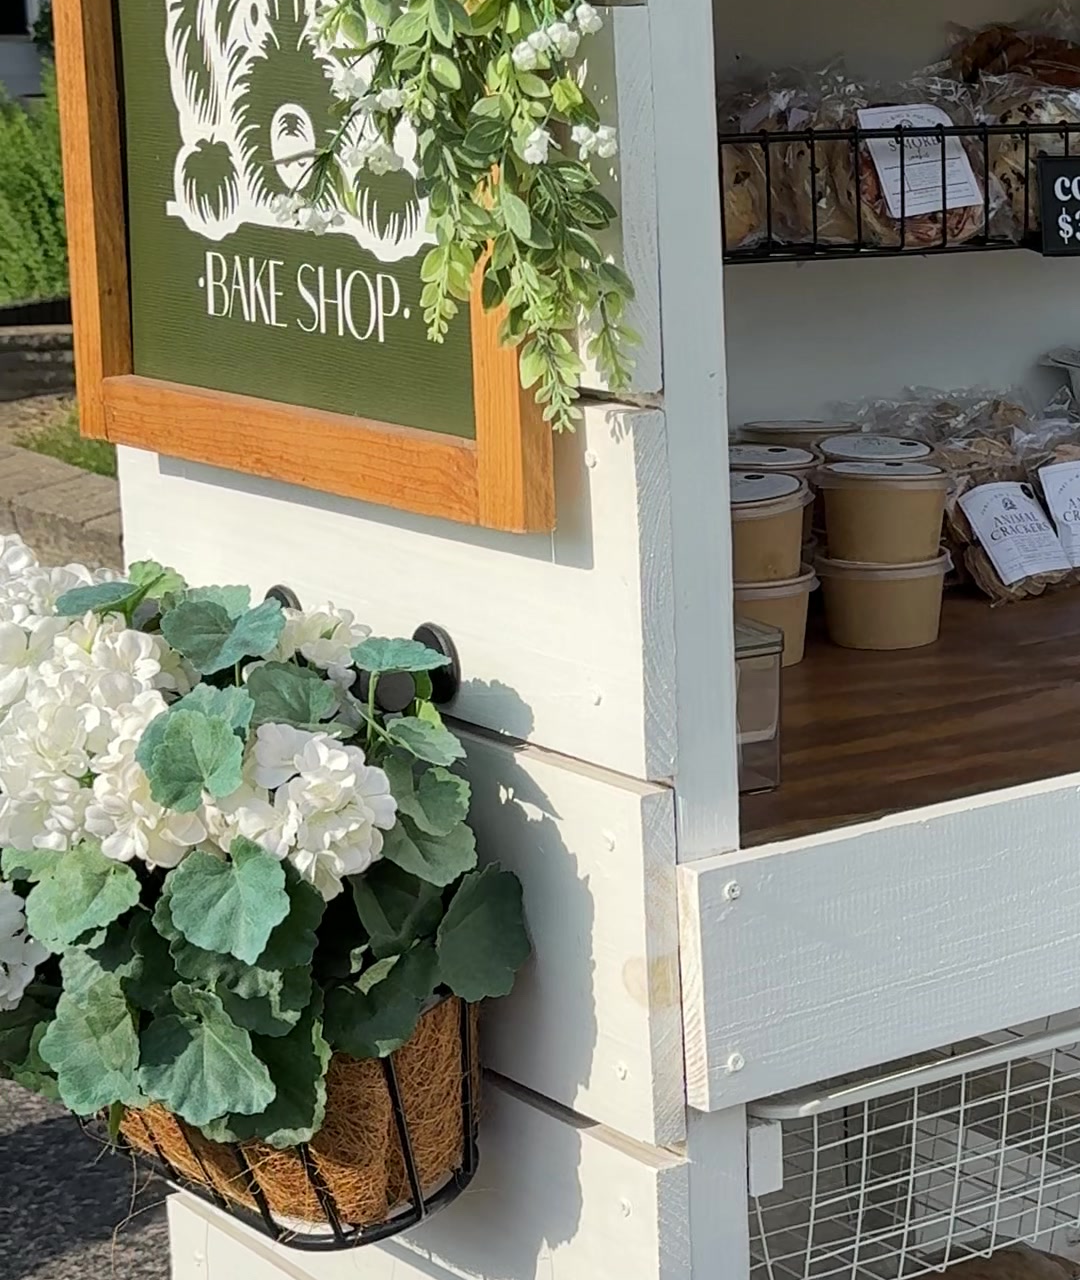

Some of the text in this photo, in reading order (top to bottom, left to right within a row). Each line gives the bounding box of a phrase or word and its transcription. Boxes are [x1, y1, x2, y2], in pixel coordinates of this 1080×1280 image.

[205, 250, 401, 343] BAKE SHOP
[992, 510, 1039, 528] ANIMAL
[990, 520, 1050, 541] CRACKERS
